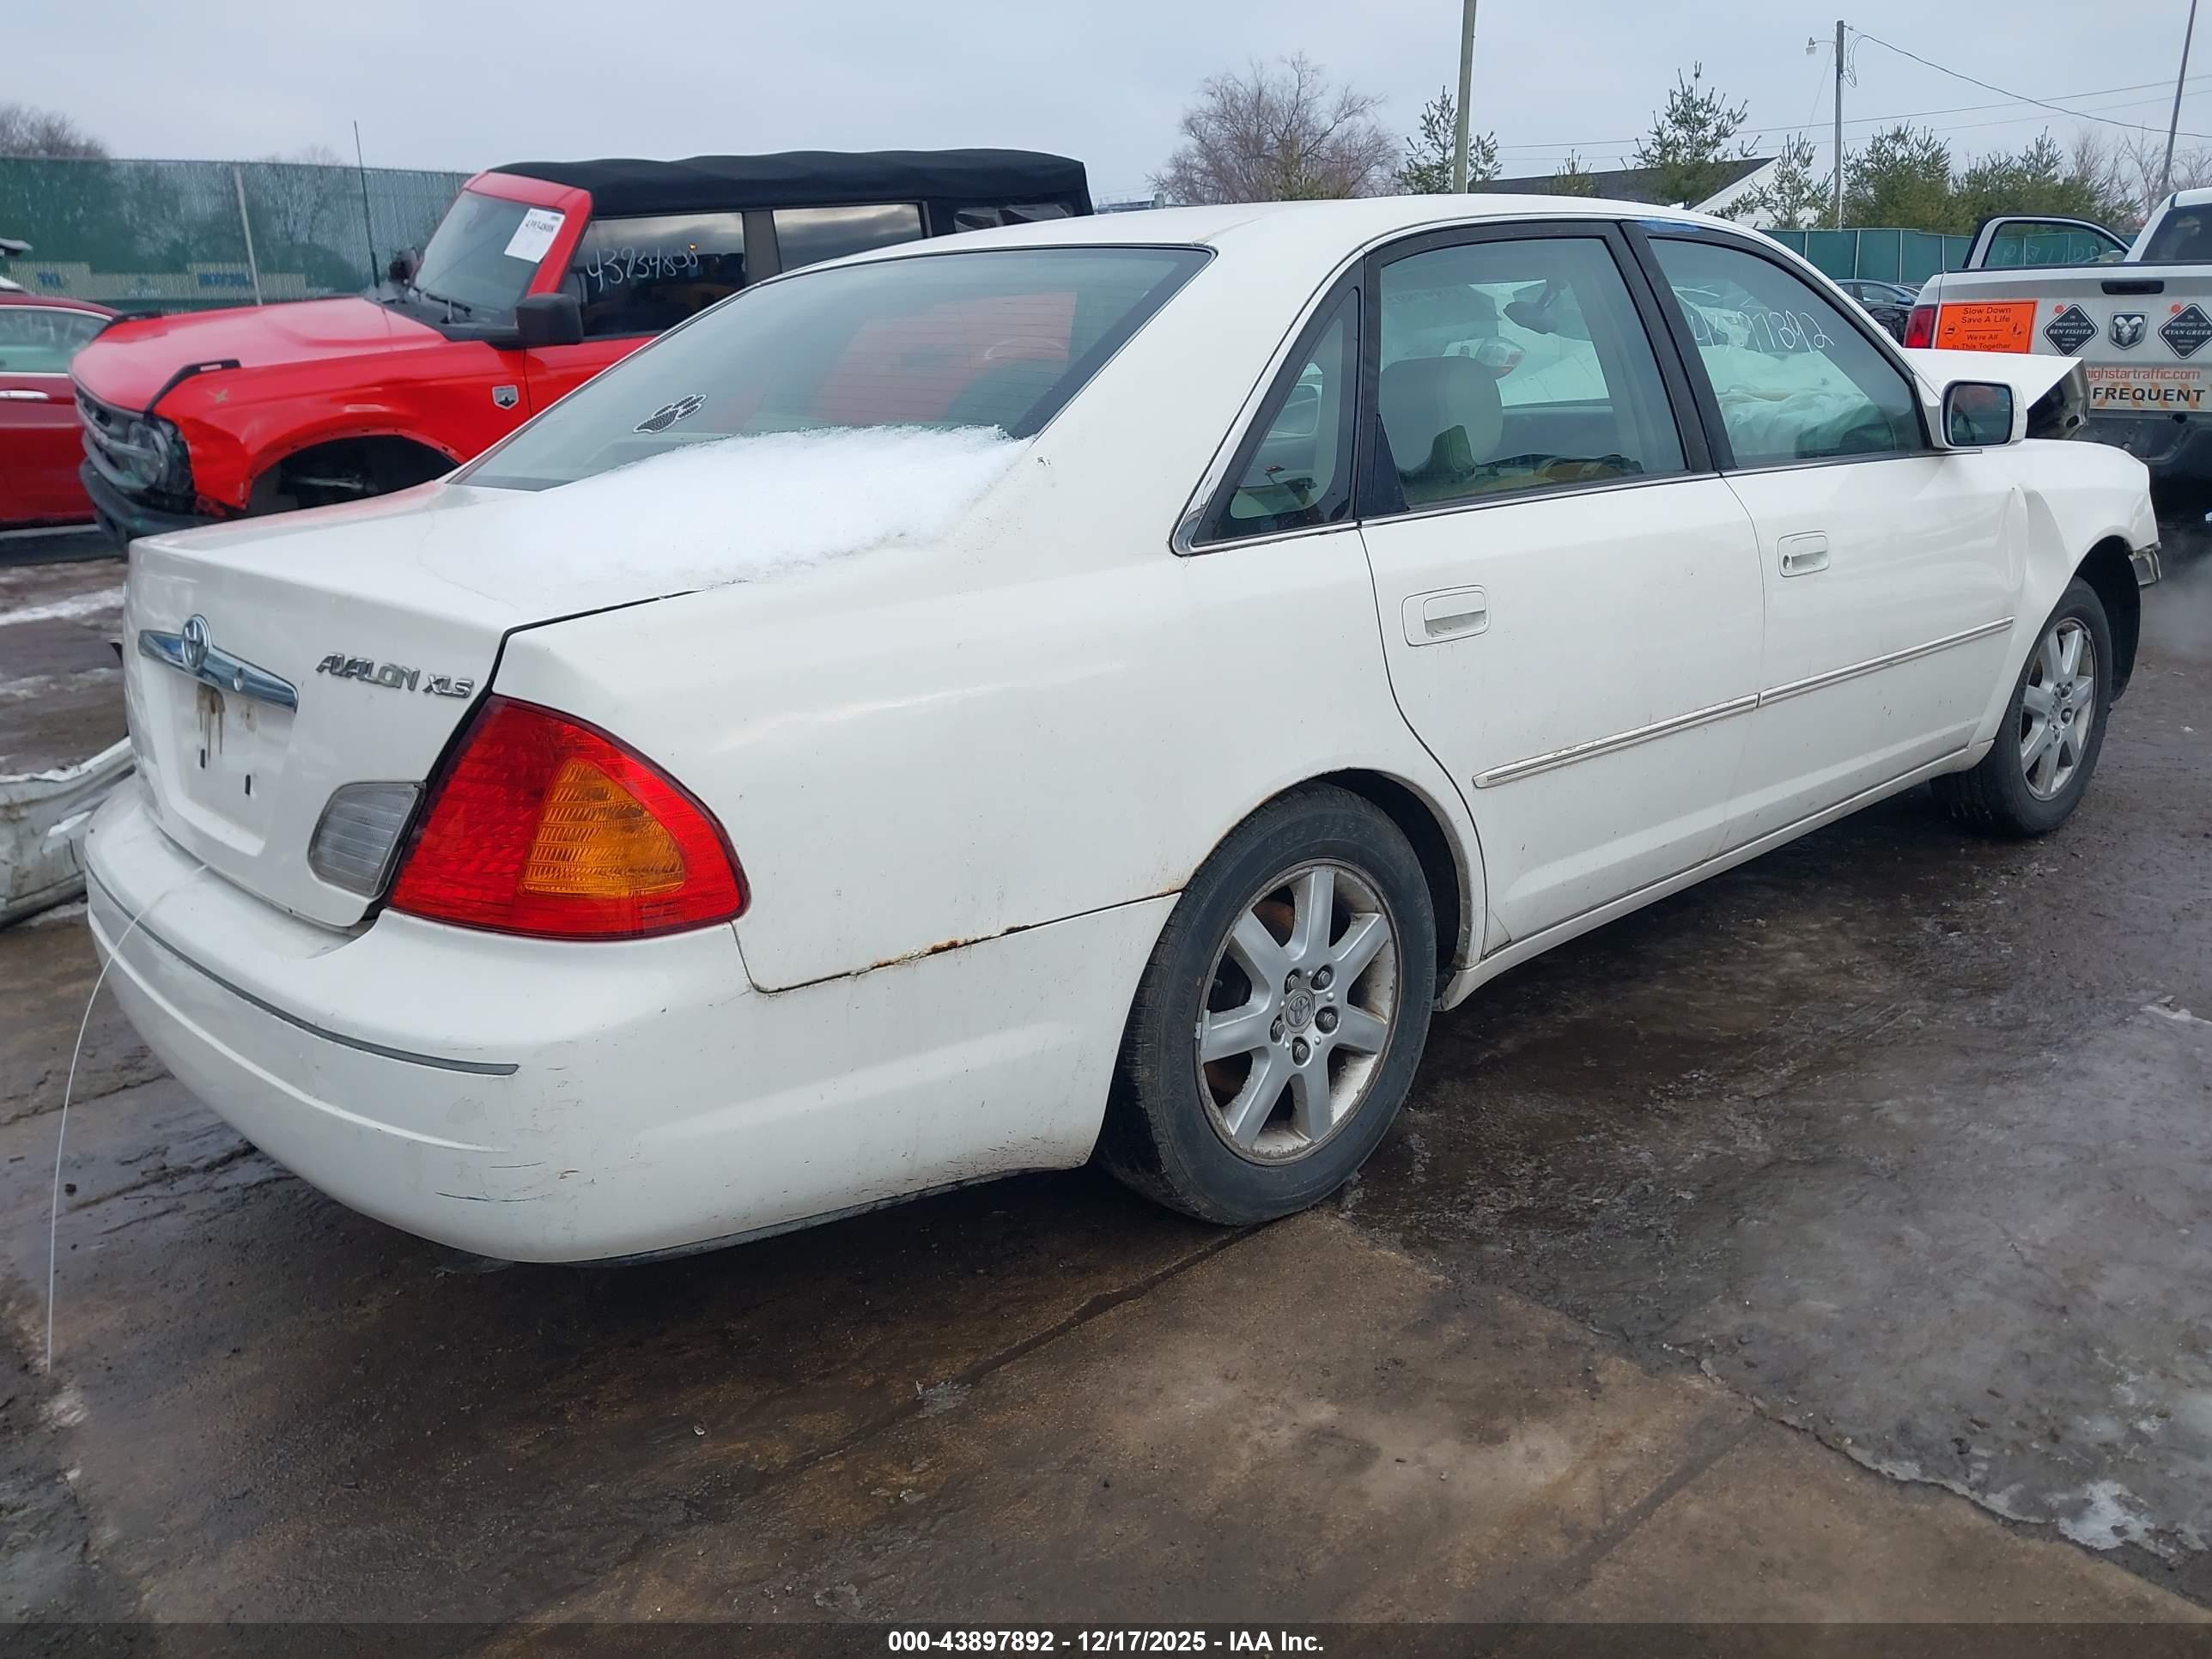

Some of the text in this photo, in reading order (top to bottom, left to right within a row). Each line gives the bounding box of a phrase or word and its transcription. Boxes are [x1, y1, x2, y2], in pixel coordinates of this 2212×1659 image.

[2093, 387, 2206, 402] FREQUENT
[315, 653, 474, 699] AVALON XLS
